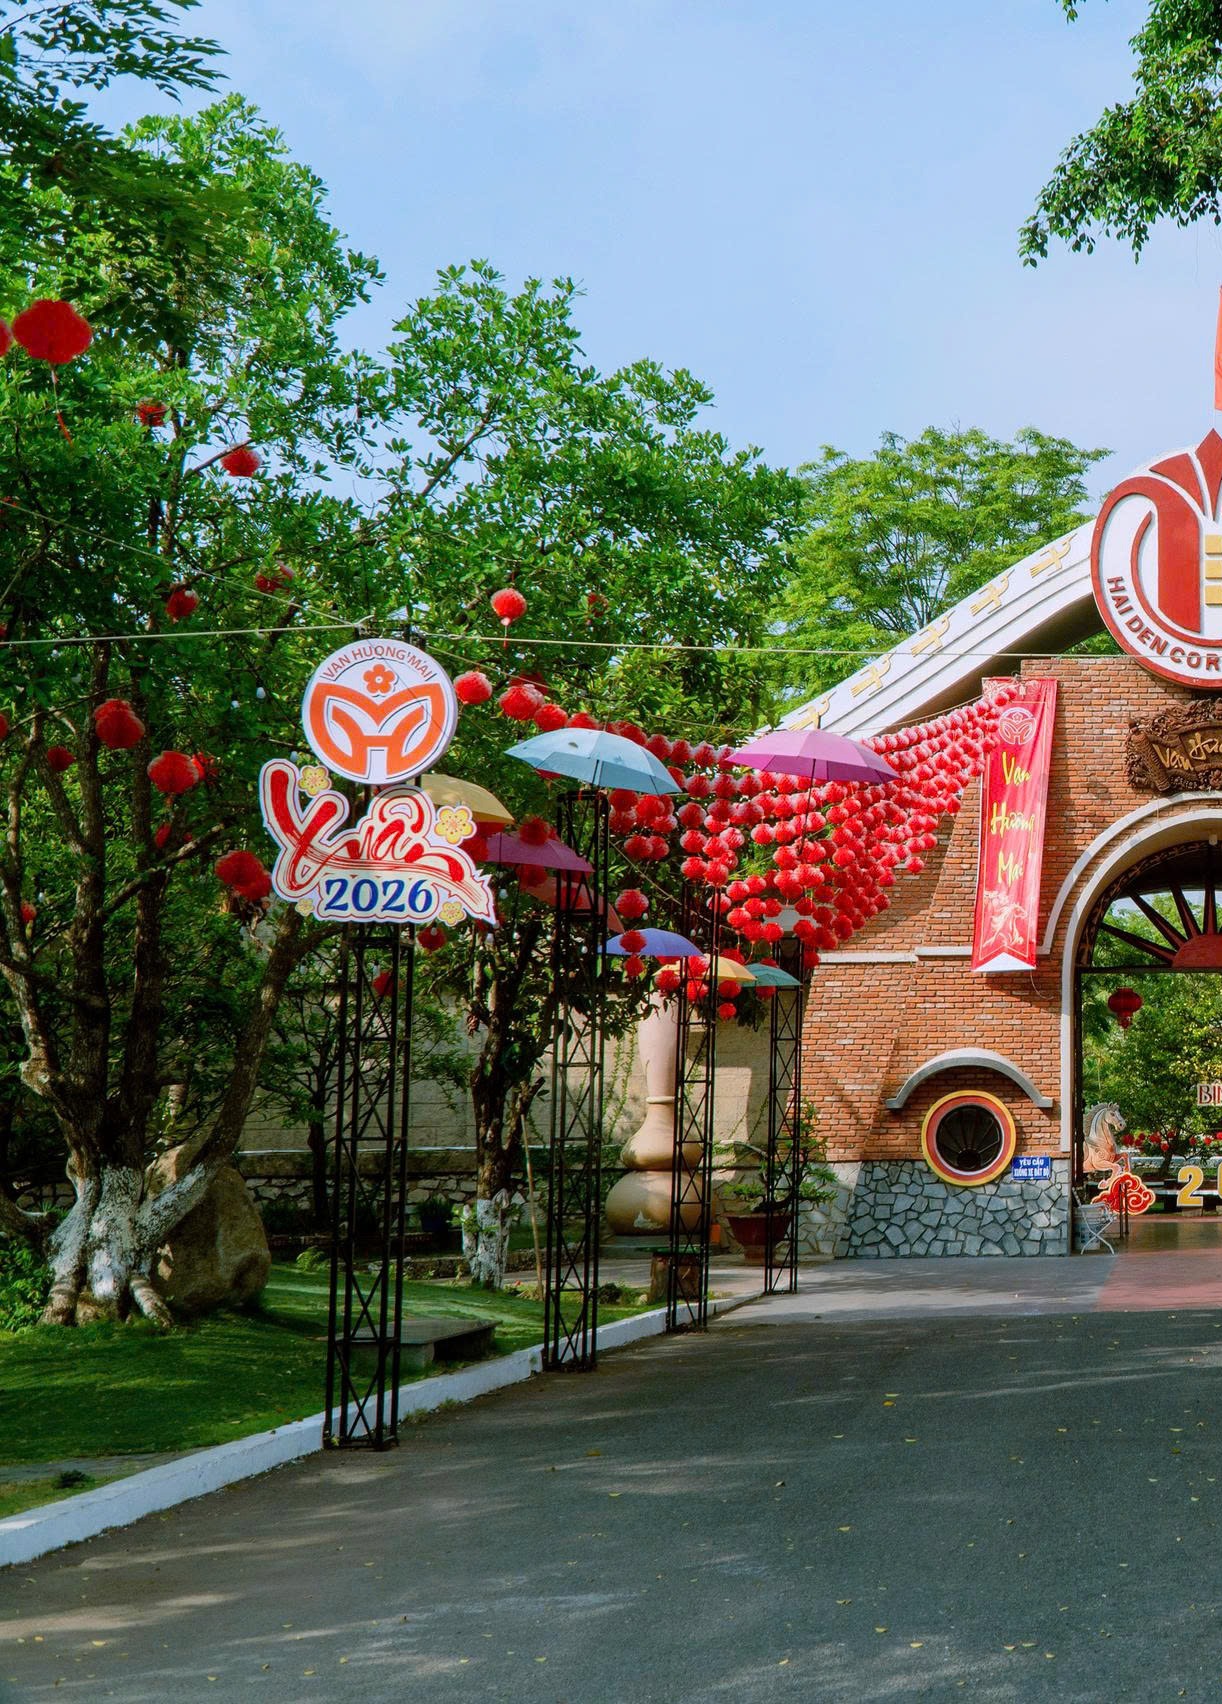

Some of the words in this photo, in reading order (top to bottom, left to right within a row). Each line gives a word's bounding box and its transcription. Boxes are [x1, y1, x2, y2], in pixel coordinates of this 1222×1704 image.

[1152, 743, 1195, 772] Vạn
[997, 850, 1024, 887] Mai
[323, 878, 434, 914] 2026
[1019, 1157, 1031, 1166] YÊU
